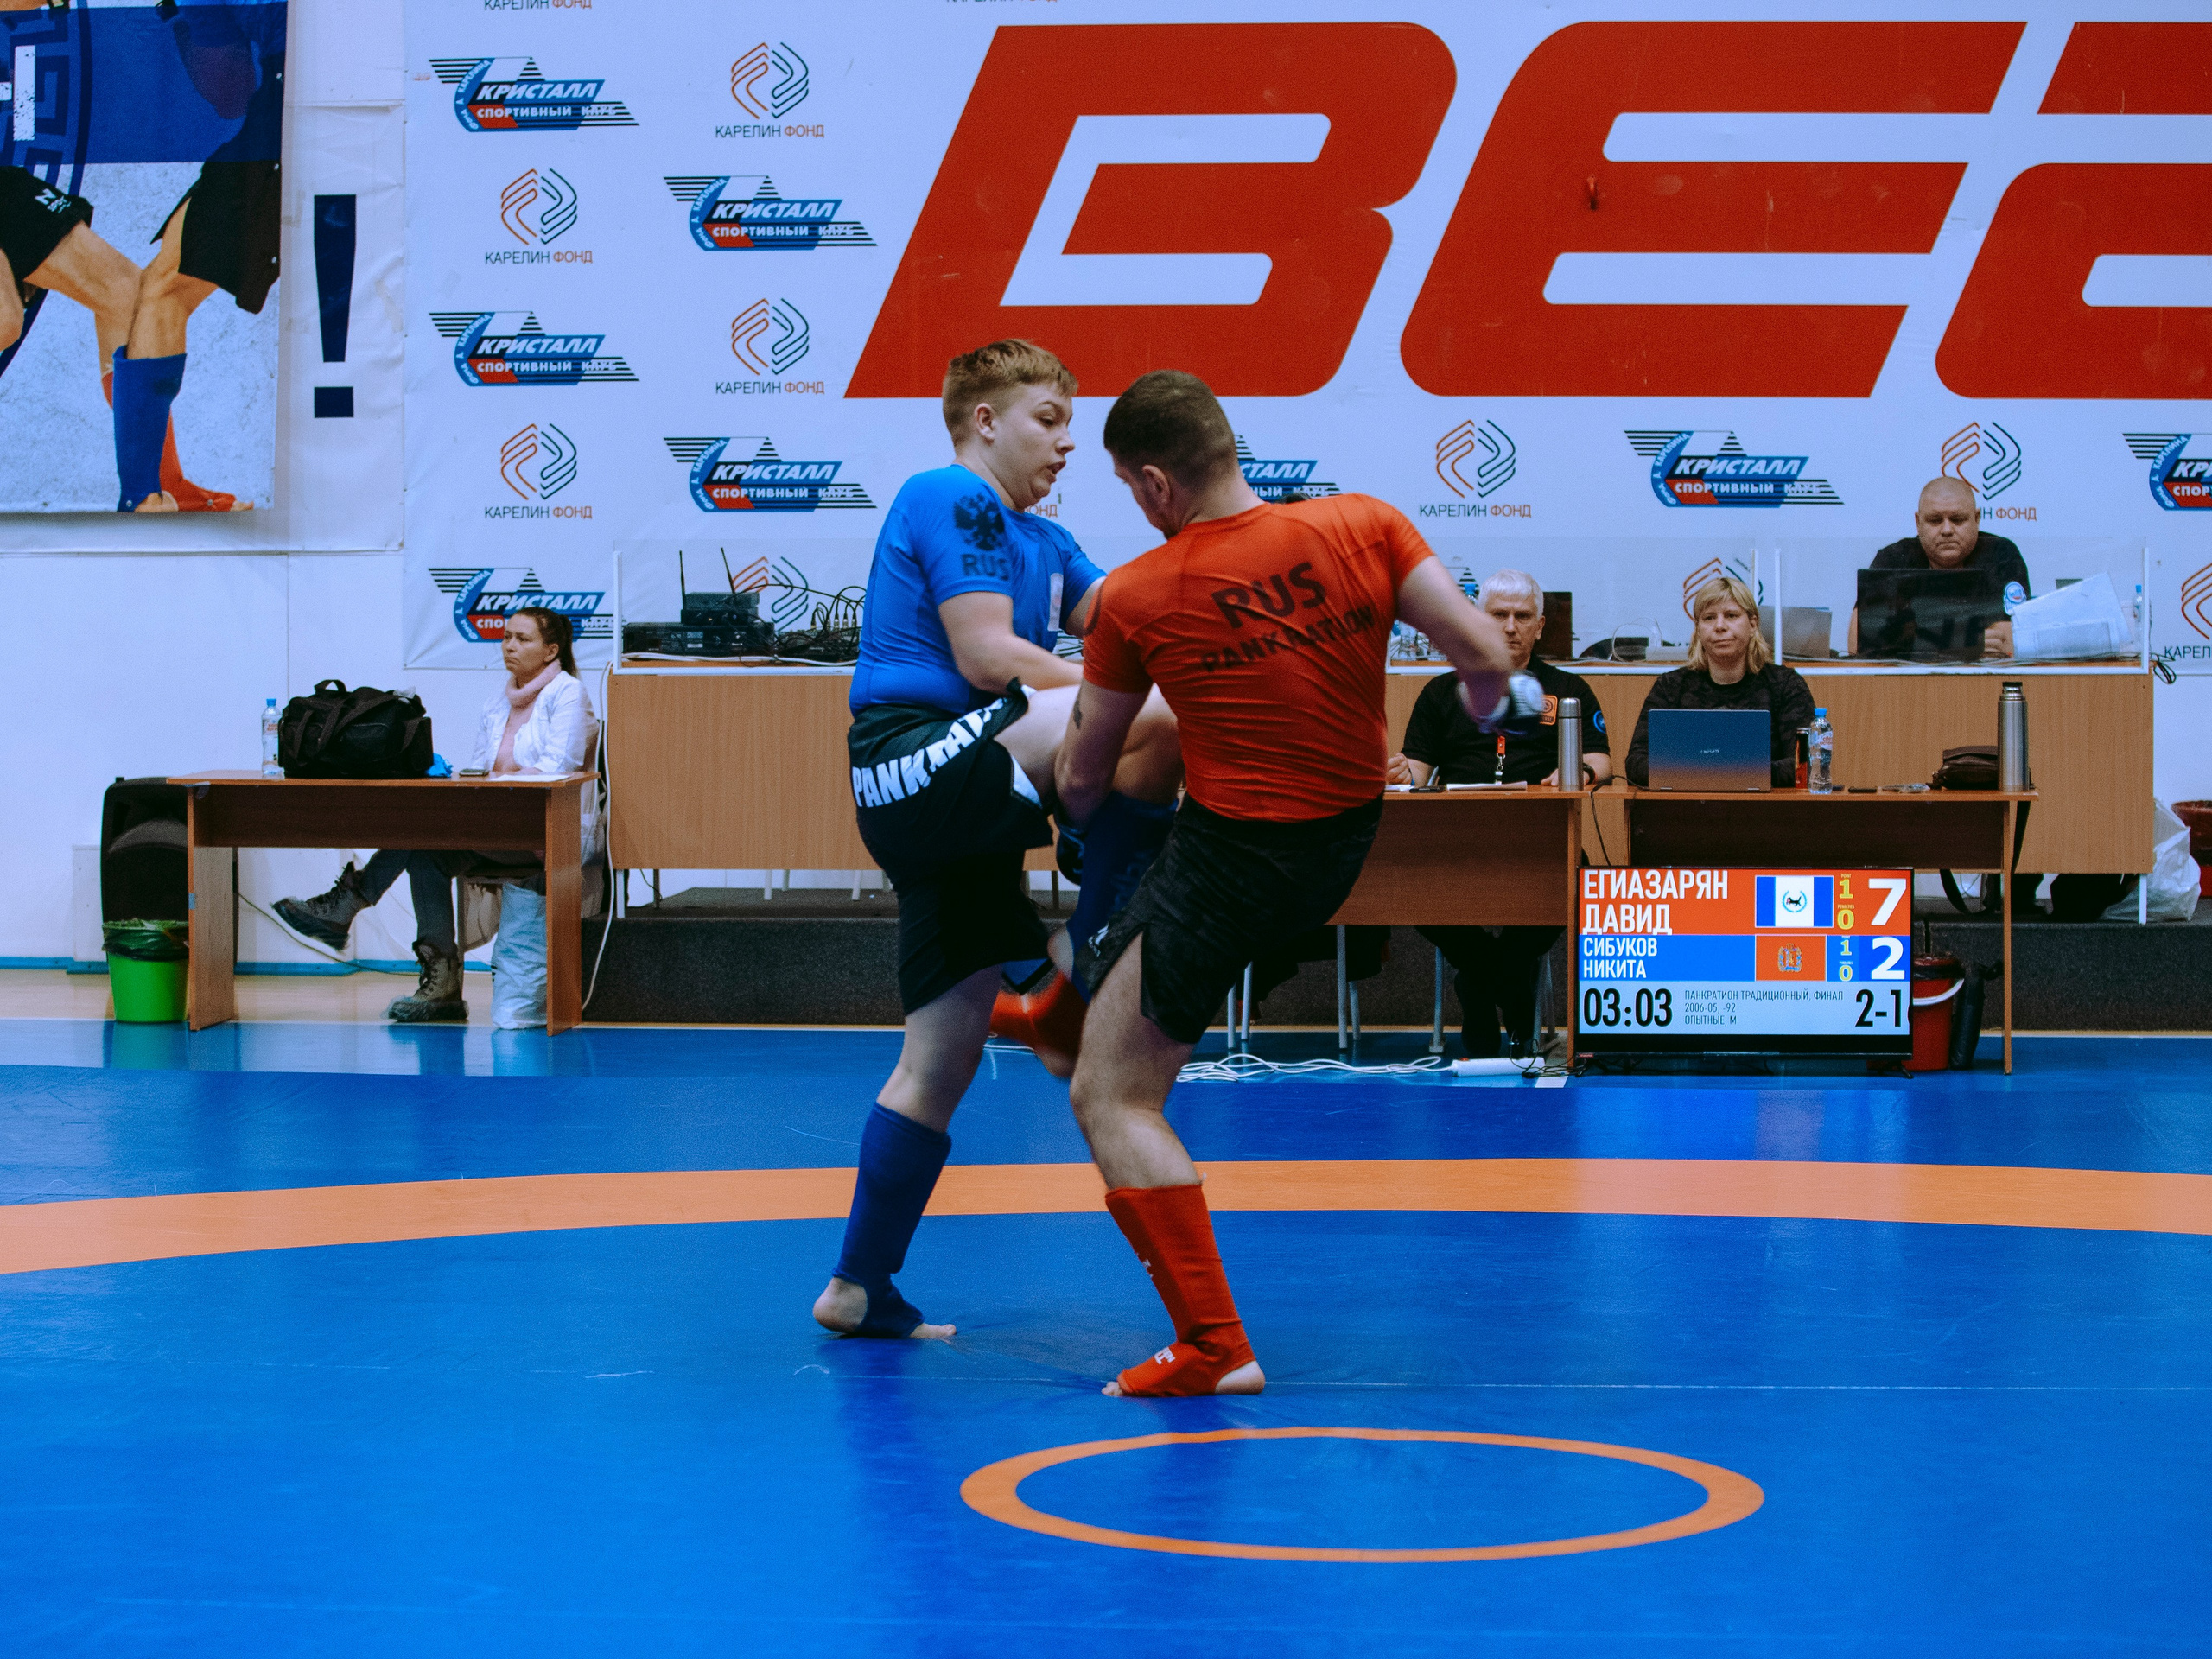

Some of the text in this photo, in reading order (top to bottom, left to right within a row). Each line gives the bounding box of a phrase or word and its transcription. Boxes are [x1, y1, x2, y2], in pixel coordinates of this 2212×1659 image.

[484, 0, 550, 10] КАРЕЛИН
[476, 83, 598, 100] КРИСТАЛЛ
[476, 105, 572, 118] СПОРТИВНЫЙ
[715, 124, 825, 138] КАРЕЛИН ФОНД
[711, 203, 836, 219] КРИСТАЛЛ
[712, 226, 809, 237] СПОРТИВНЫЙ
[485, 250, 593, 264] КАРЕЛИН ФОНД
[476, 338, 598, 354] КРИСТАЛЛ
[476, 360, 572, 372] СПОРТИВНЫЙ
[715, 381, 825, 395] КАРЕЛИН ФОНД
[711, 464, 836, 480] КРИСТАЛЛ
[1675, 459, 1802, 474] КРИСТАЛЛ
[712, 486, 809, 499] СПОРТИВНЫЙ
[1675, 481, 1774, 493] СПОРТИВНЫЙ
[485, 505, 593, 519] КАРЕЛИН ФОНД
[1025, 504, 1058, 518] ОНД
[1420, 505, 1531, 518] КАРЕЛИН ФОНД
[1995, 507, 2037, 522] ФОНД
[476, 594, 598, 611] КРИСТАЛЛ
[1211, 562, 1326, 629] RUS
[2164, 645, 2212, 659] КАРЕЛ
[1584, 869, 1728, 899] ЕГИАЗАРЯН
[1839, 879, 1853, 899] 1
[1868, 877, 1907, 926] 7
[1582, 904, 1673, 936] ДАВИД
[1837, 909, 1854, 930] 0
[1583, 938, 1658, 957] СИБУКОВ
[1840, 939, 1852, 956] 1
[1871, 936, 1905, 980] 2
[1583, 959, 1647, 978] НИКИТА
[1839, 964, 1853, 982] 0
[1685, 988, 1844, 1001] ПАНКРАТИОН ТРАДИЦИОННЫЙ, ФИНАЛ
[1583, 988, 1673, 1027] 03:03
[1685, 1002, 1736, 1014] 2006-05, -92
[1855, 988, 1902, 1027] 2-1
[1685, 1015, 1737, 1027] ОПЫТНЫЕ, М
